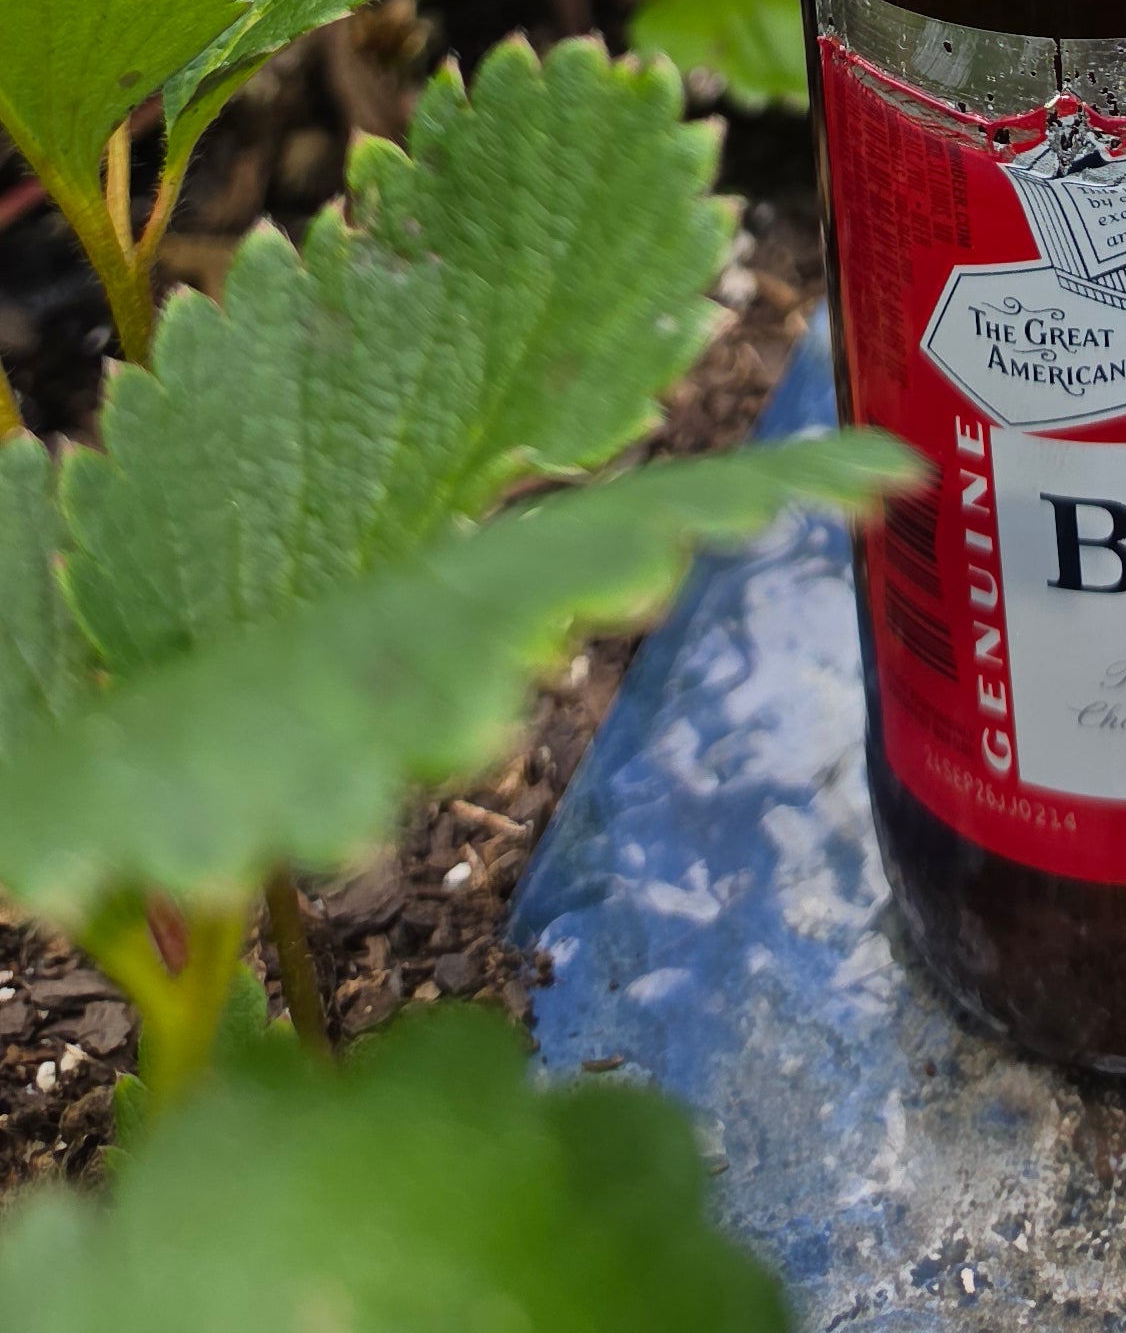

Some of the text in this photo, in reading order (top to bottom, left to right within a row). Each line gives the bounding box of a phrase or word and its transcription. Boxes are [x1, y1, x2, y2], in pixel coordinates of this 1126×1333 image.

[1088, 197, 1113, 209] by
[968, 305, 1115, 354] THE GREAT
[987, 343, 1126, 397] AMERICAN
[955, 414, 1013, 773] GENUINE
